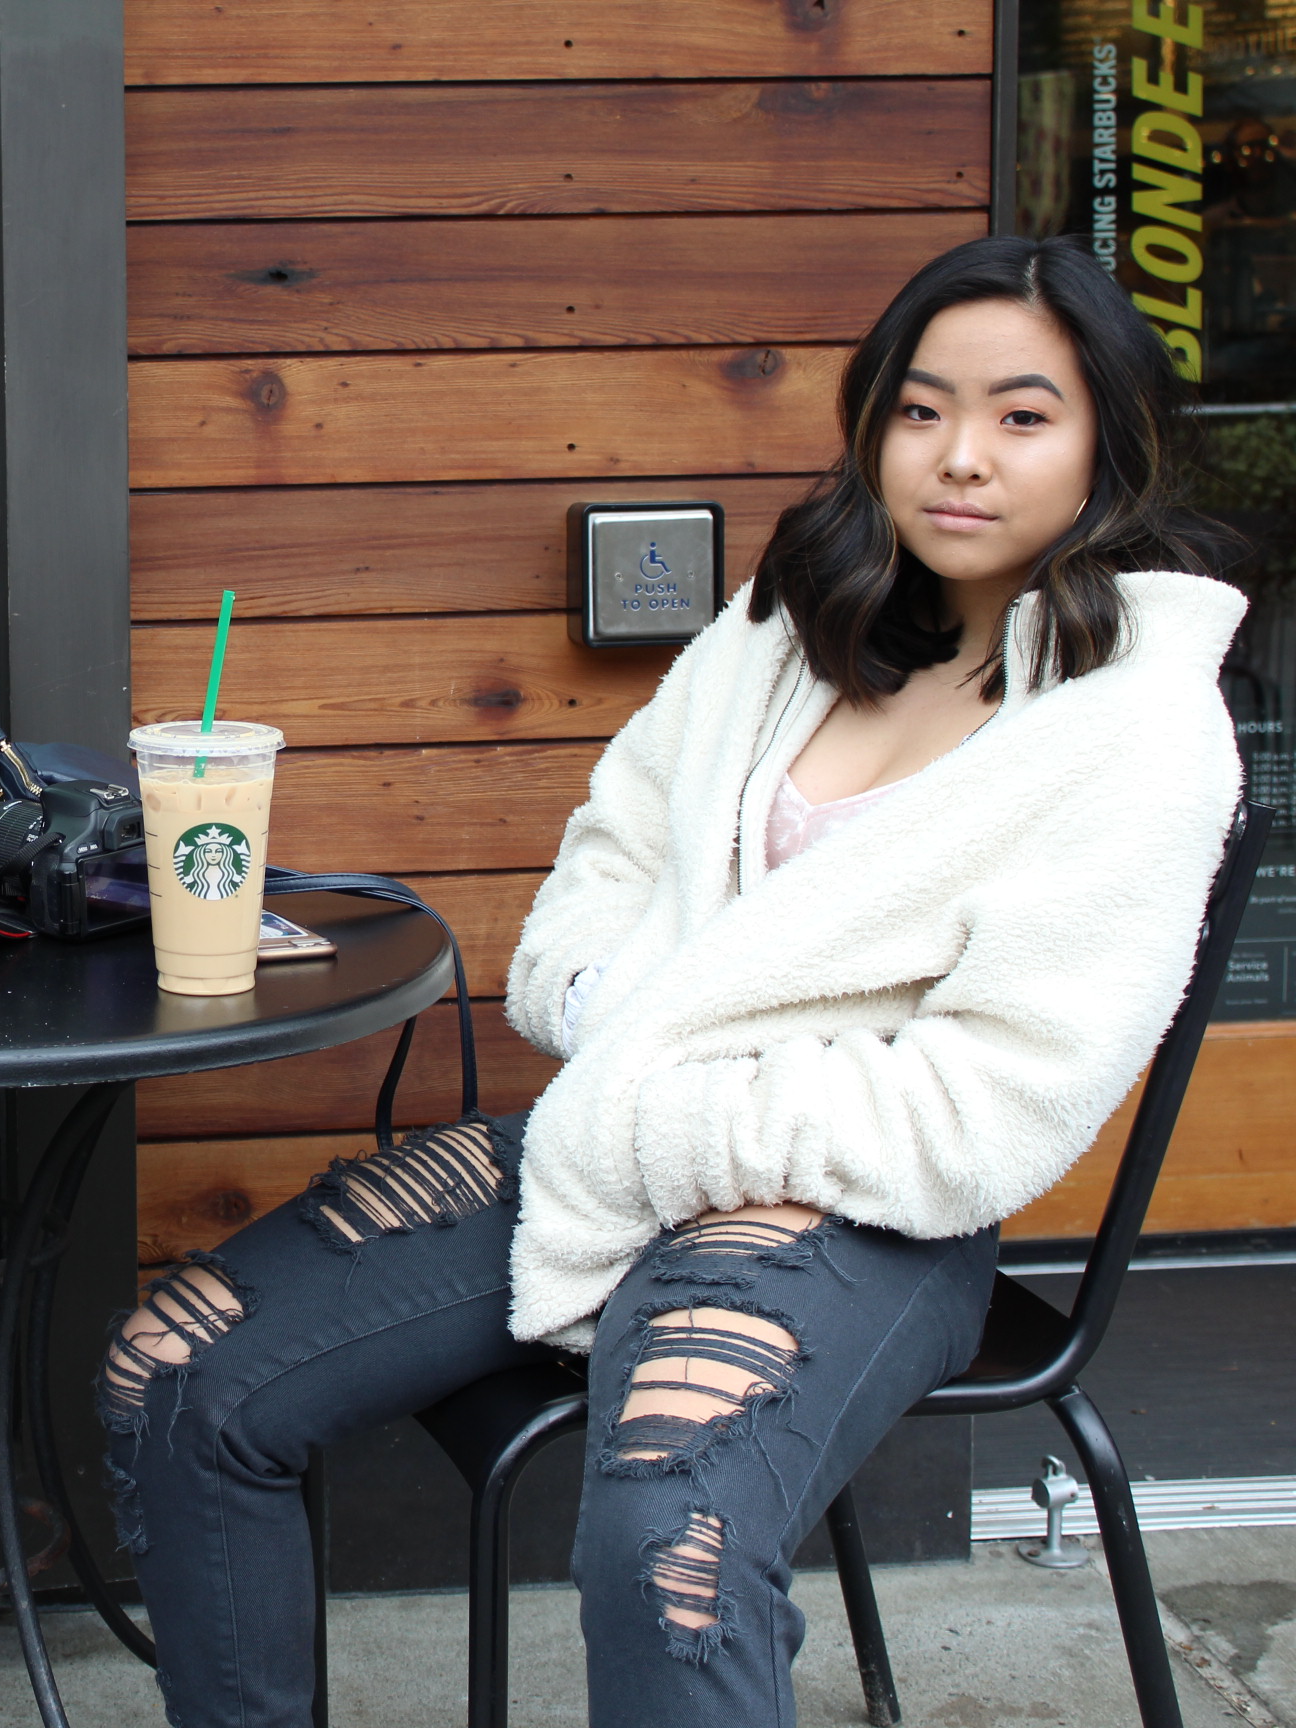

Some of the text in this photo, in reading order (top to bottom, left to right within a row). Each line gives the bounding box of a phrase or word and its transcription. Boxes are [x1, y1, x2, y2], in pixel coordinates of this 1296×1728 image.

[1131, 56, 1204, 384] BLONDE
[1093, 196, 1117, 273] UCING
[634, 583, 678, 596] PUSH
[621, 598, 691, 611] TO OPEN
[1237, 721, 1284, 734] HOURS
